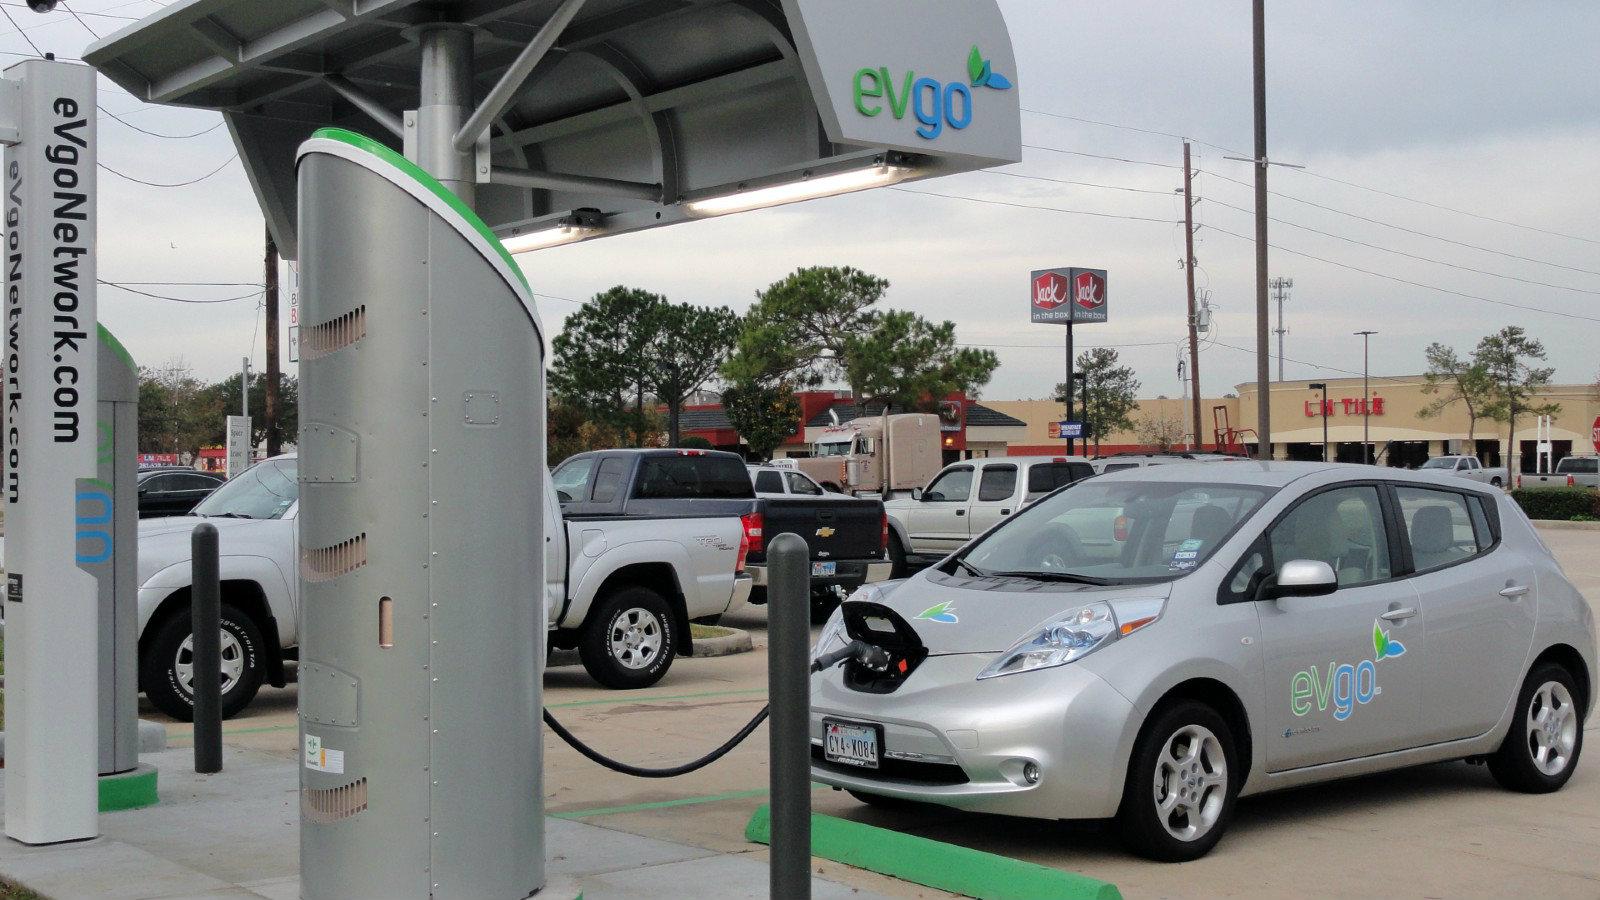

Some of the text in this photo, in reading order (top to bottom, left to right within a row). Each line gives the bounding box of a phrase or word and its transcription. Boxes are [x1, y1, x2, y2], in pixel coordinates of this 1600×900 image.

[45, 97, 87, 442] eVgoNetwork.com
[1034, 276, 1067, 304] Jack
[1075, 276, 1104, 304] Jack
[1041, 311, 1053, 319] the
[1054, 311, 1069, 319] box
[1341, 397, 1384, 416] TILE
